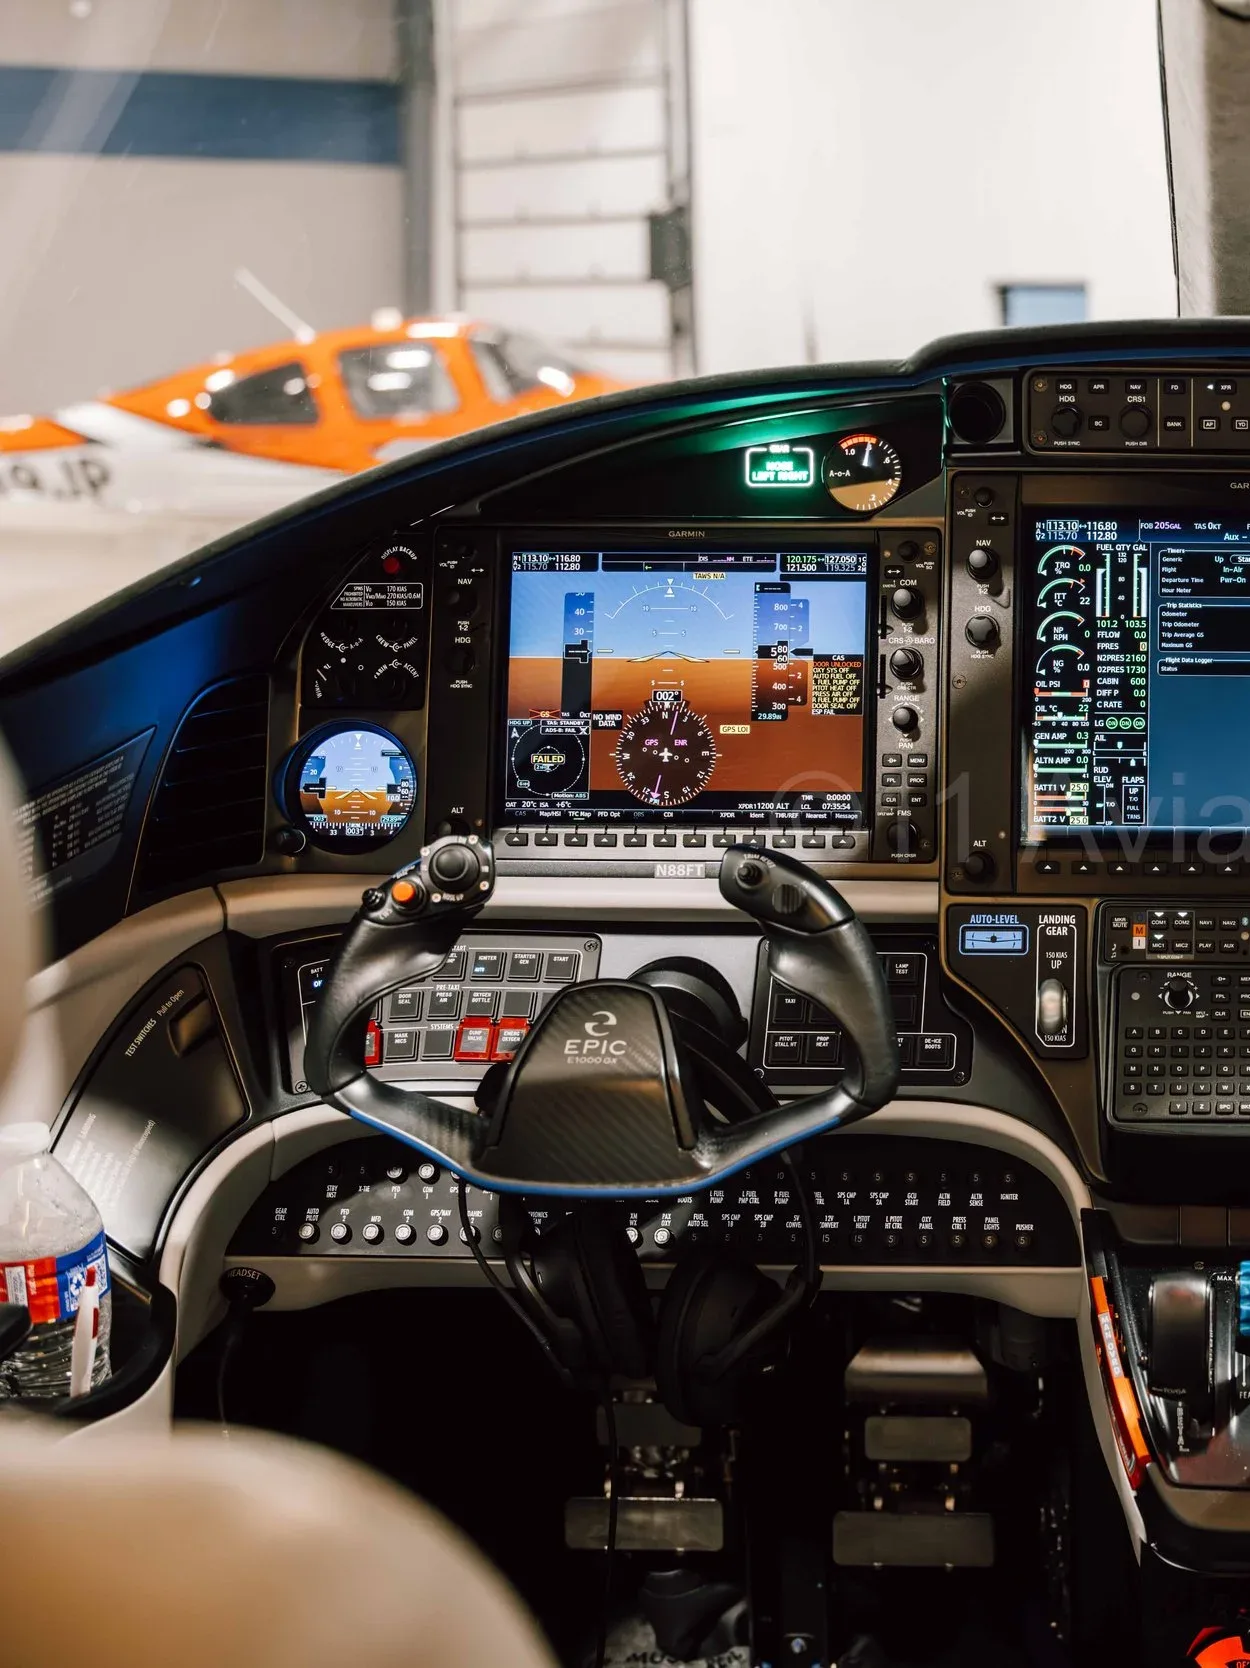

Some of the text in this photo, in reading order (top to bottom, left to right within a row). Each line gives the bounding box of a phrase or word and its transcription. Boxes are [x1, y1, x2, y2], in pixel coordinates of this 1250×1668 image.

[1058, 395, 1076, 403] HDG
[1127, 395, 1146, 403] CRS1
[752, 471, 809, 481] LEFT RIGHT
[1047, 521, 1117, 531] 113.10 116.80
[669, 530, 706, 538] GARMIN
[1047, 531, 1117, 541] 115.70 112.80
[1224, 533, 1239, 542] Aux
[1116, 544, 1131, 552] QTY
[381, 546, 418, 561] DISPLAY BACKUP
[523, 554, 581, 562] 113.10 116.80
[786, 555, 856, 564] 120.175 127.050
[555, 563, 580, 571] 112.80
[786, 563, 856, 572] 121.500 119.325
[774, 603, 788, 611] 800
[1096, 620, 1146, 628] 101.2 103.5
[1097, 631, 1120, 639] FFLOW
[320, 632, 335, 648] WEDGE
[375, 634, 418, 649] CREW PANEL
[1097, 654, 1146, 663] N2PRES 2160
[403, 663, 419, 679] ACCENT
[1125, 666, 1146, 674] 1730
[1097, 677, 1146, 686] CABIN 600
[894, 694, 920, 702] RANGE
[532, 755, 564, 763] FAILED
[1122, 776, 1145, 784] FLAPS
[656, 864, 704, 876] N88FT
[970, 914, 1019, 924] AUTO-LEVEL
[1039, 915, 1076, 924] LANDING
[1046, 926, 1068, 936] GEAR
[1051, 960, 1062, 969] UP
[156, 1005, 168, 1017] Pull
[170, 989, 184, 1003] Open
[125, 1018, 157, 1057] TEST SWITCHES
[563, 1040, 627, 1055] EPIC
[567, 1056, 602, 1065] E1000
[1000, 1193, 1019, 1201] IGNITER
[1015, 1223, 1034, 1231] PUSHER
